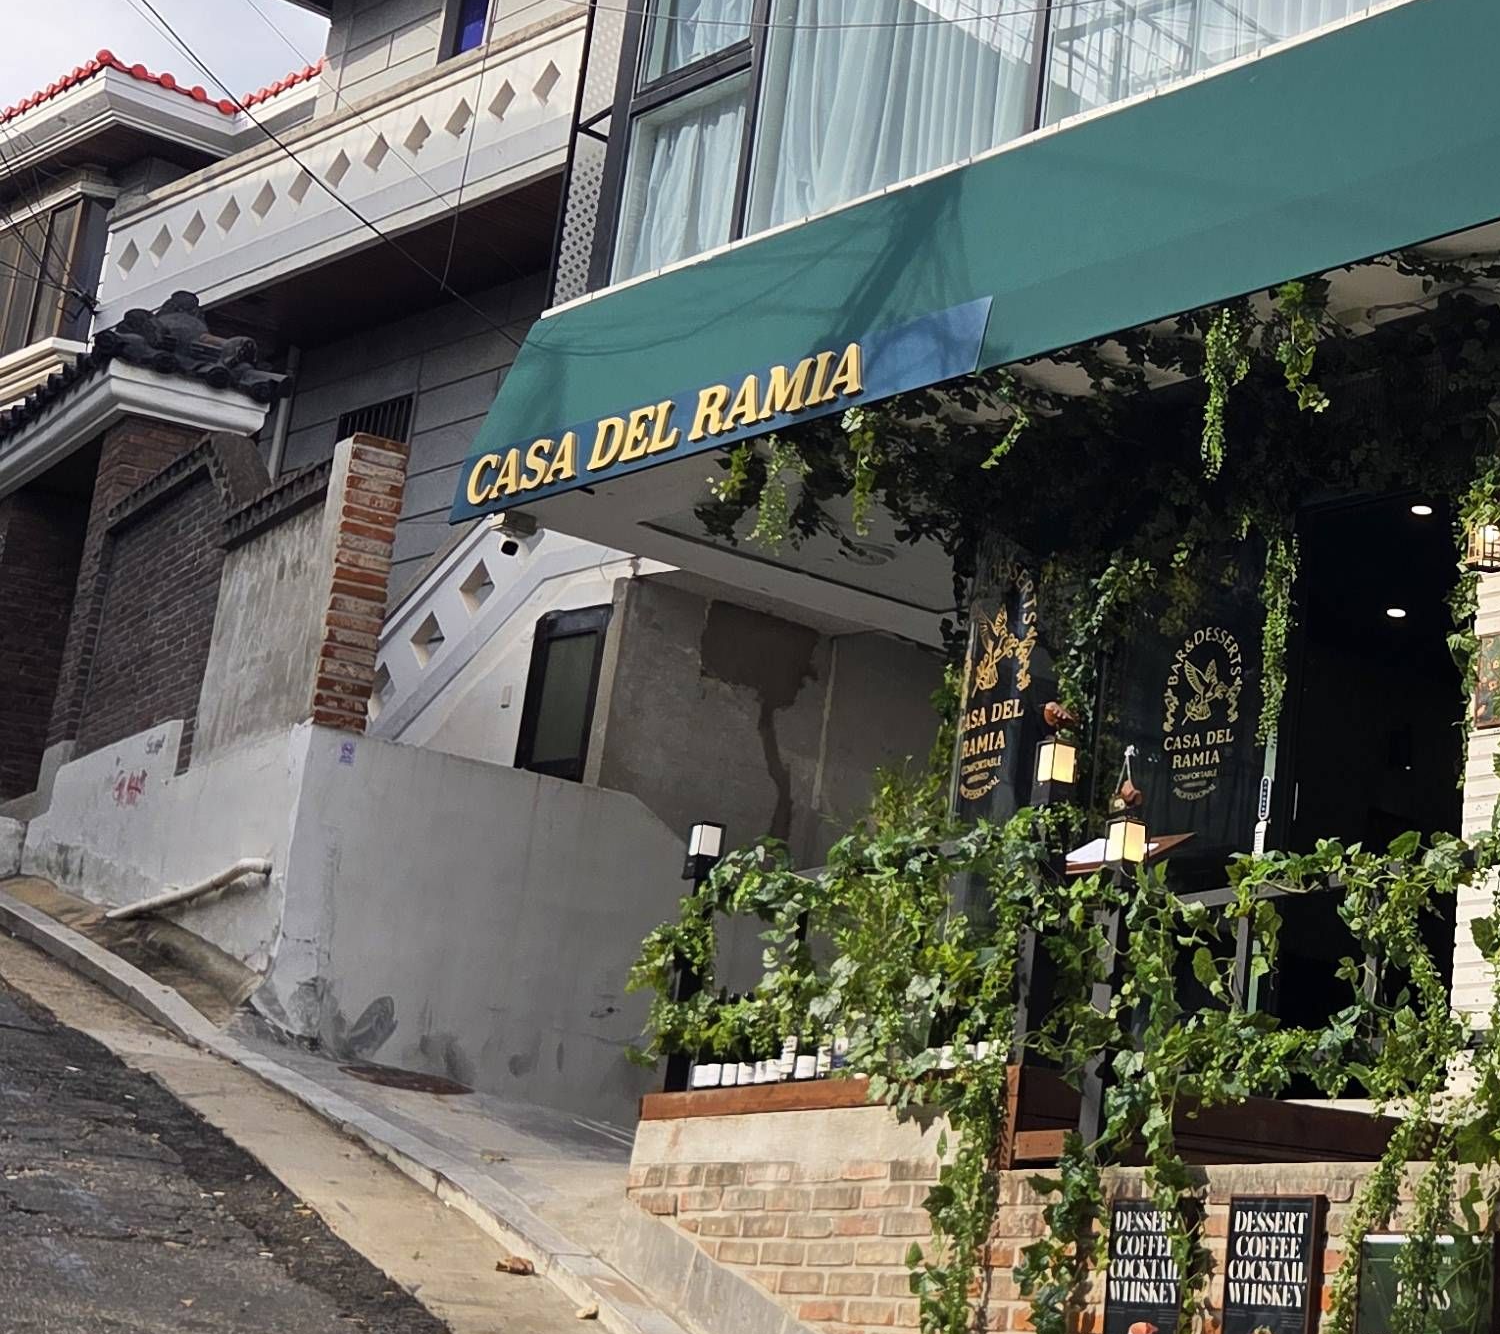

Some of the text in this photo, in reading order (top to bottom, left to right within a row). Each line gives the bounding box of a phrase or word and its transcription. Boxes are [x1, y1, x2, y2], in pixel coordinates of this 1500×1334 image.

[467, 343, 863, 505] CASA DEL RAMIA
[991, 698, 1024, 723] DEL
[961, 730, 1005, 760] RAMIA
[1164, 728, 1234, 751] CASA DEL
[1172, 749, 1220, 769] RAMIA
[1115, 1211, 1176, 1232] DESSER
[1234, 1211, 1308, 1234] DESSERT
[1235, 1235, 1302, 1259] COFFEE
[1109, 1259, 1181, 1280] COCKTAIL
[1228, 1259, 1308, 1283] COCKTAIL
[1109, 1281, 1180, 1304] WHISKEY
[1228, 1282, 1305, 1307] WHISKEY
